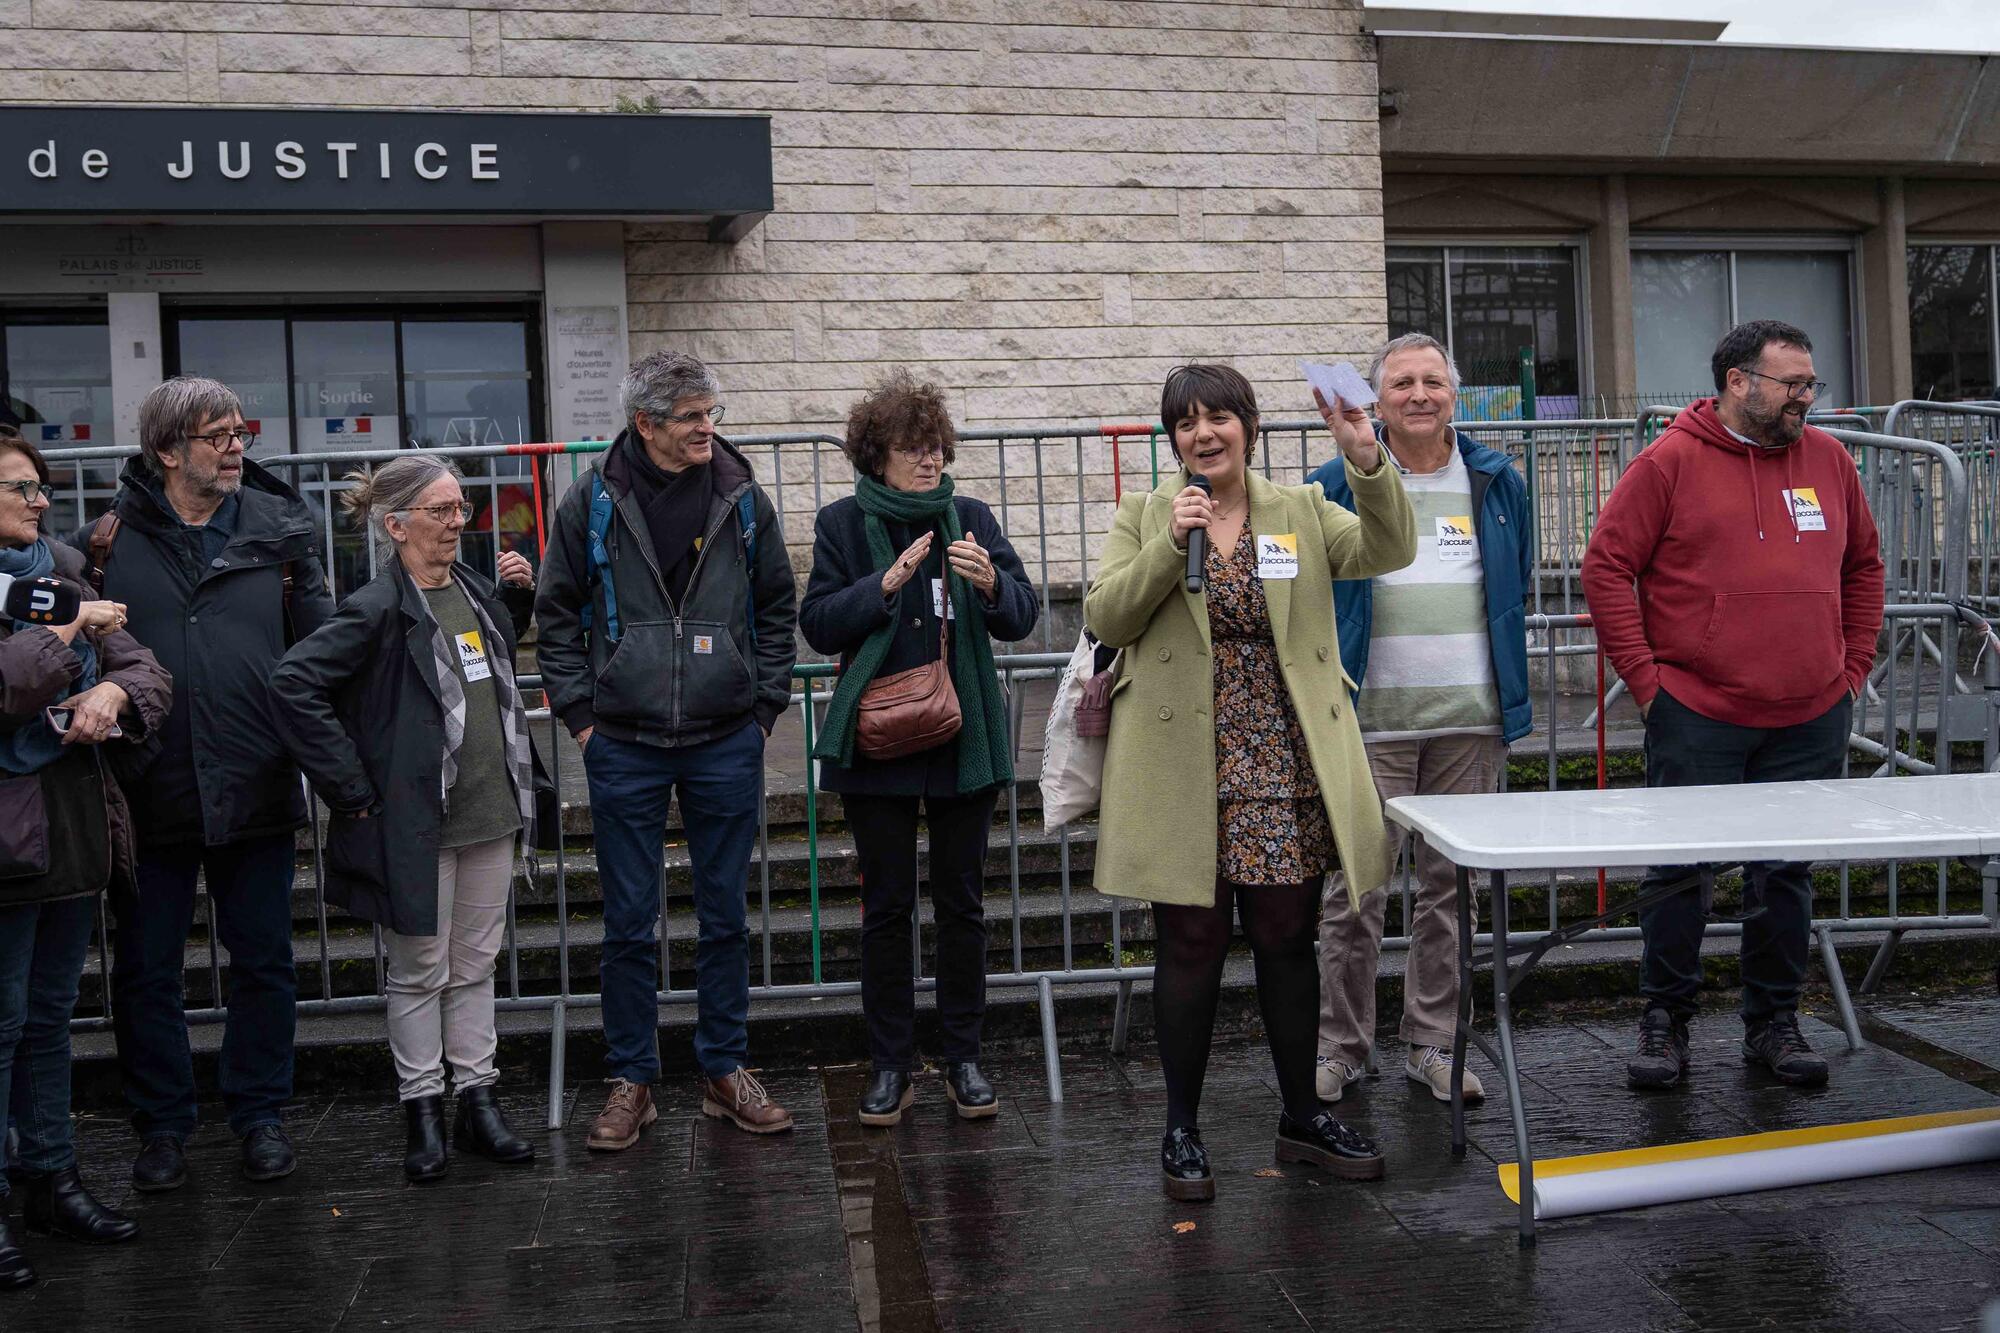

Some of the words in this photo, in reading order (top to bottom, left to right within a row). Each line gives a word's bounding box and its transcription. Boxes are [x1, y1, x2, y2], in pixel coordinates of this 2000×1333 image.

[27, 139, 109, 178] de
[167, 140, 500, 180] JUSTICE
[59, 259, 119, 270] PALAIS
[145, 258, 205, 270] JUSTICE
[320, 388, 374, 405] Sortie
[1438, 538, 1473, 546] J'accuse
[1258, 556, 1298, 565] J'accuse
